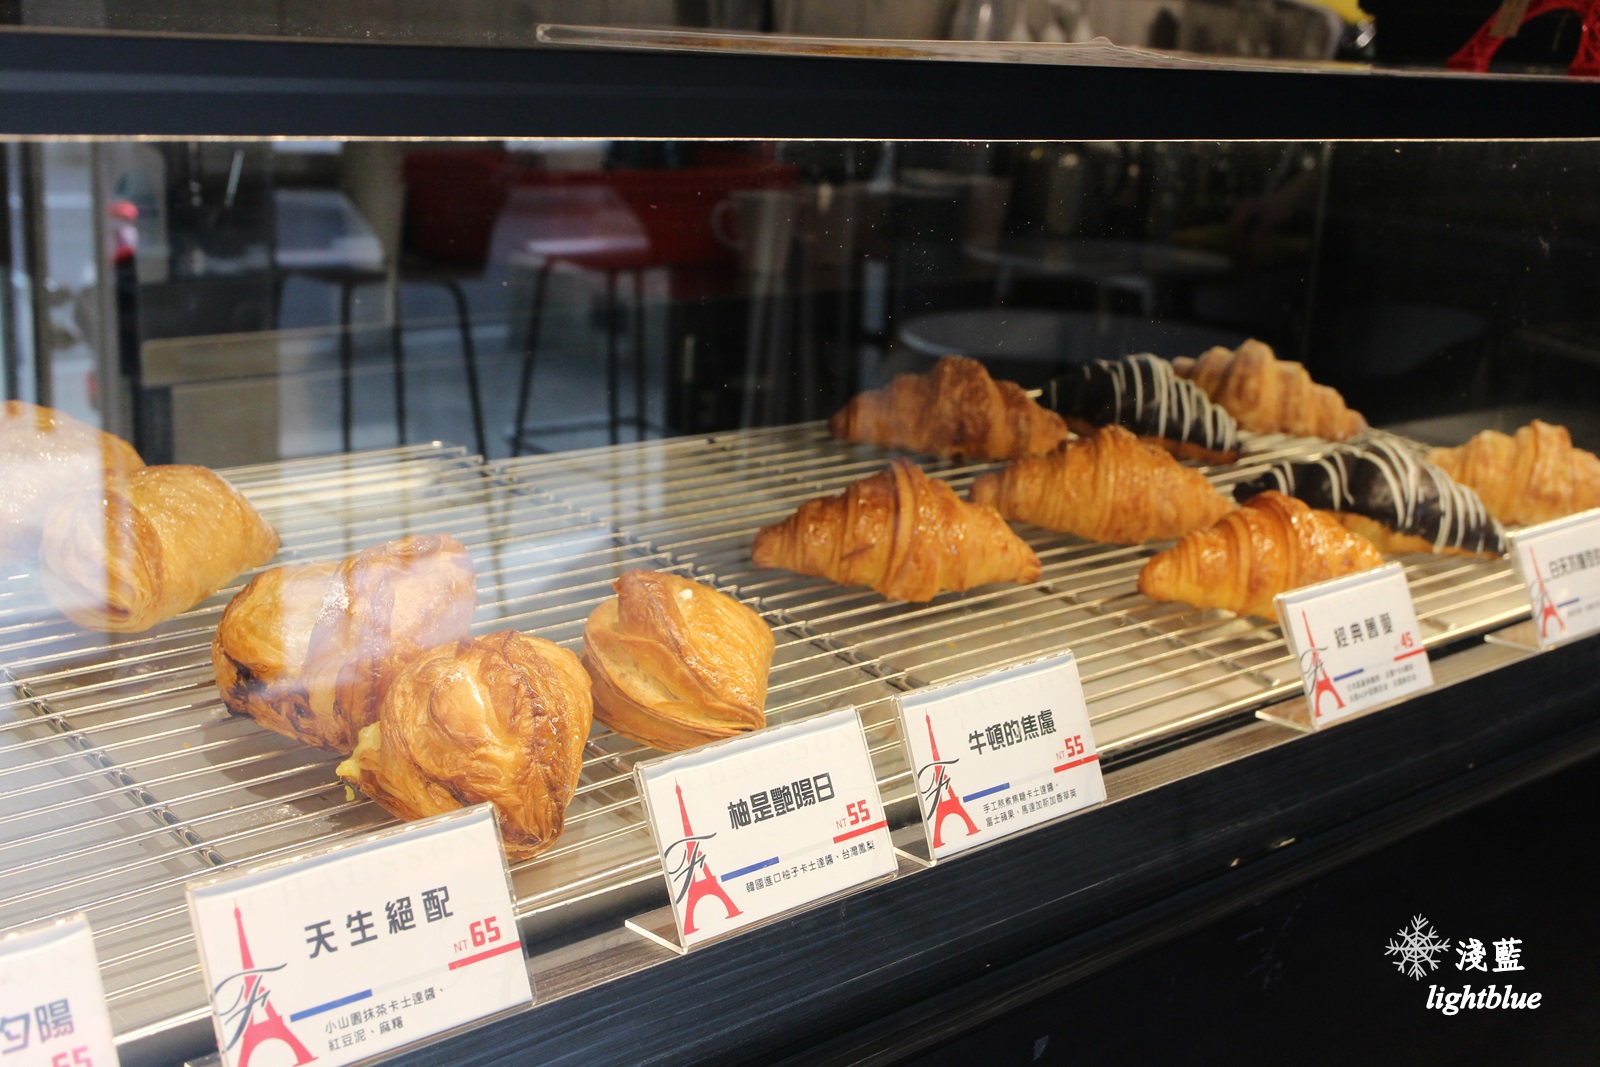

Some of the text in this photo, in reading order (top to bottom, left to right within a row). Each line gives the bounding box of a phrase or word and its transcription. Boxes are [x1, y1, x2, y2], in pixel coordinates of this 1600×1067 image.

[968, 709, 1057, 755] 牛頓的焦慮
[1056, 735, 1085, 761] NT 55
[727, 772, 835, 830] 柚是艷陽日
[835, 799, 871, 829] NT 55
[304, 886, 453, 959] 天生絕配
[453, 916, 501, 953] NT 65
